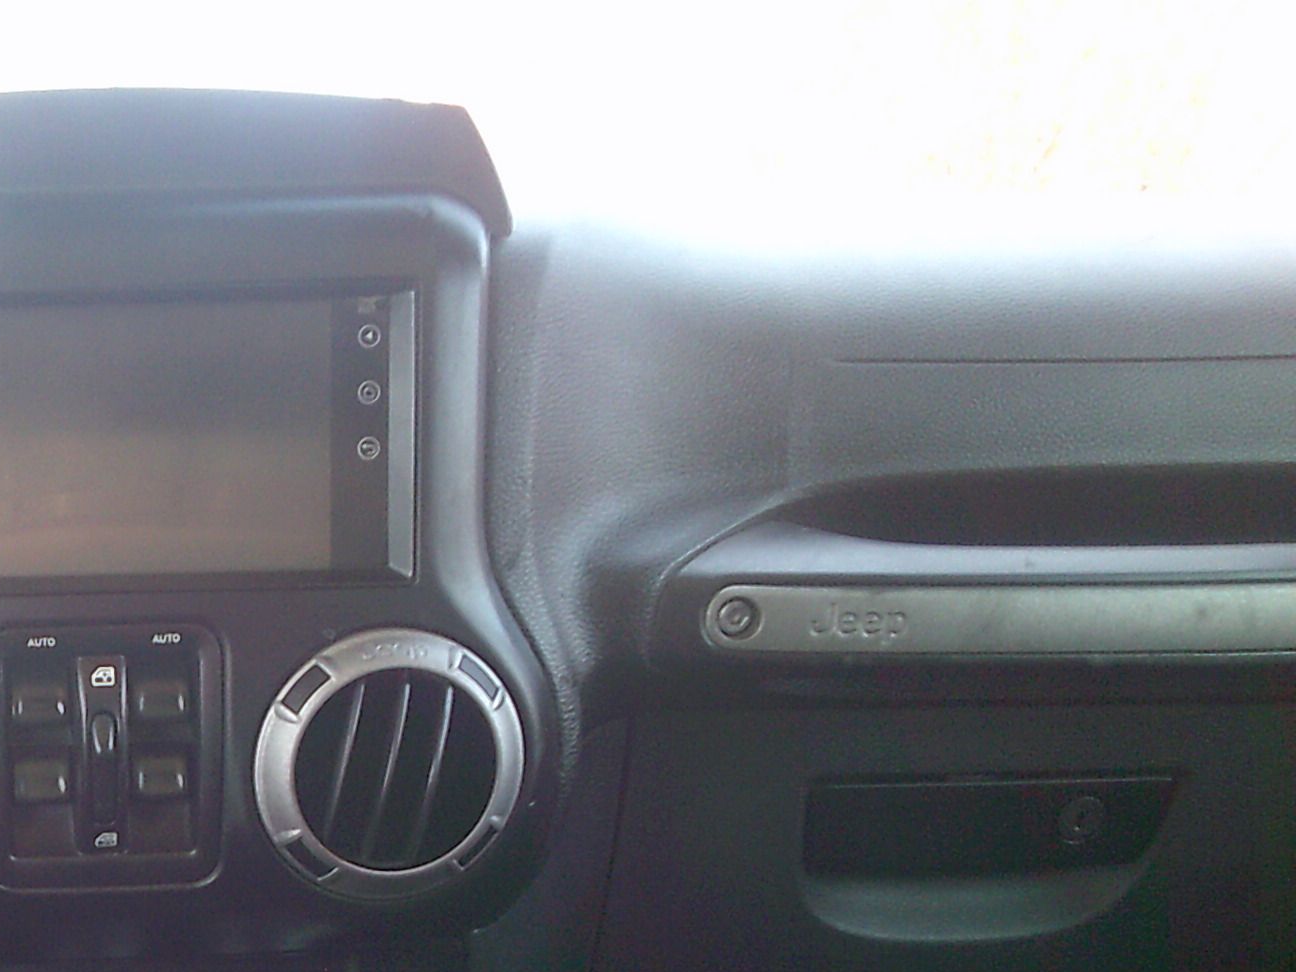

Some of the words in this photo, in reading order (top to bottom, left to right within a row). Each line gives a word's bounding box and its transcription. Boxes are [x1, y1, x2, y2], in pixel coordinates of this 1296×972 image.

[809, 602, 907, 646] Jeep
[27, 637, 56, 648] AUTO
[151, 633, 181, 644] AUTO
